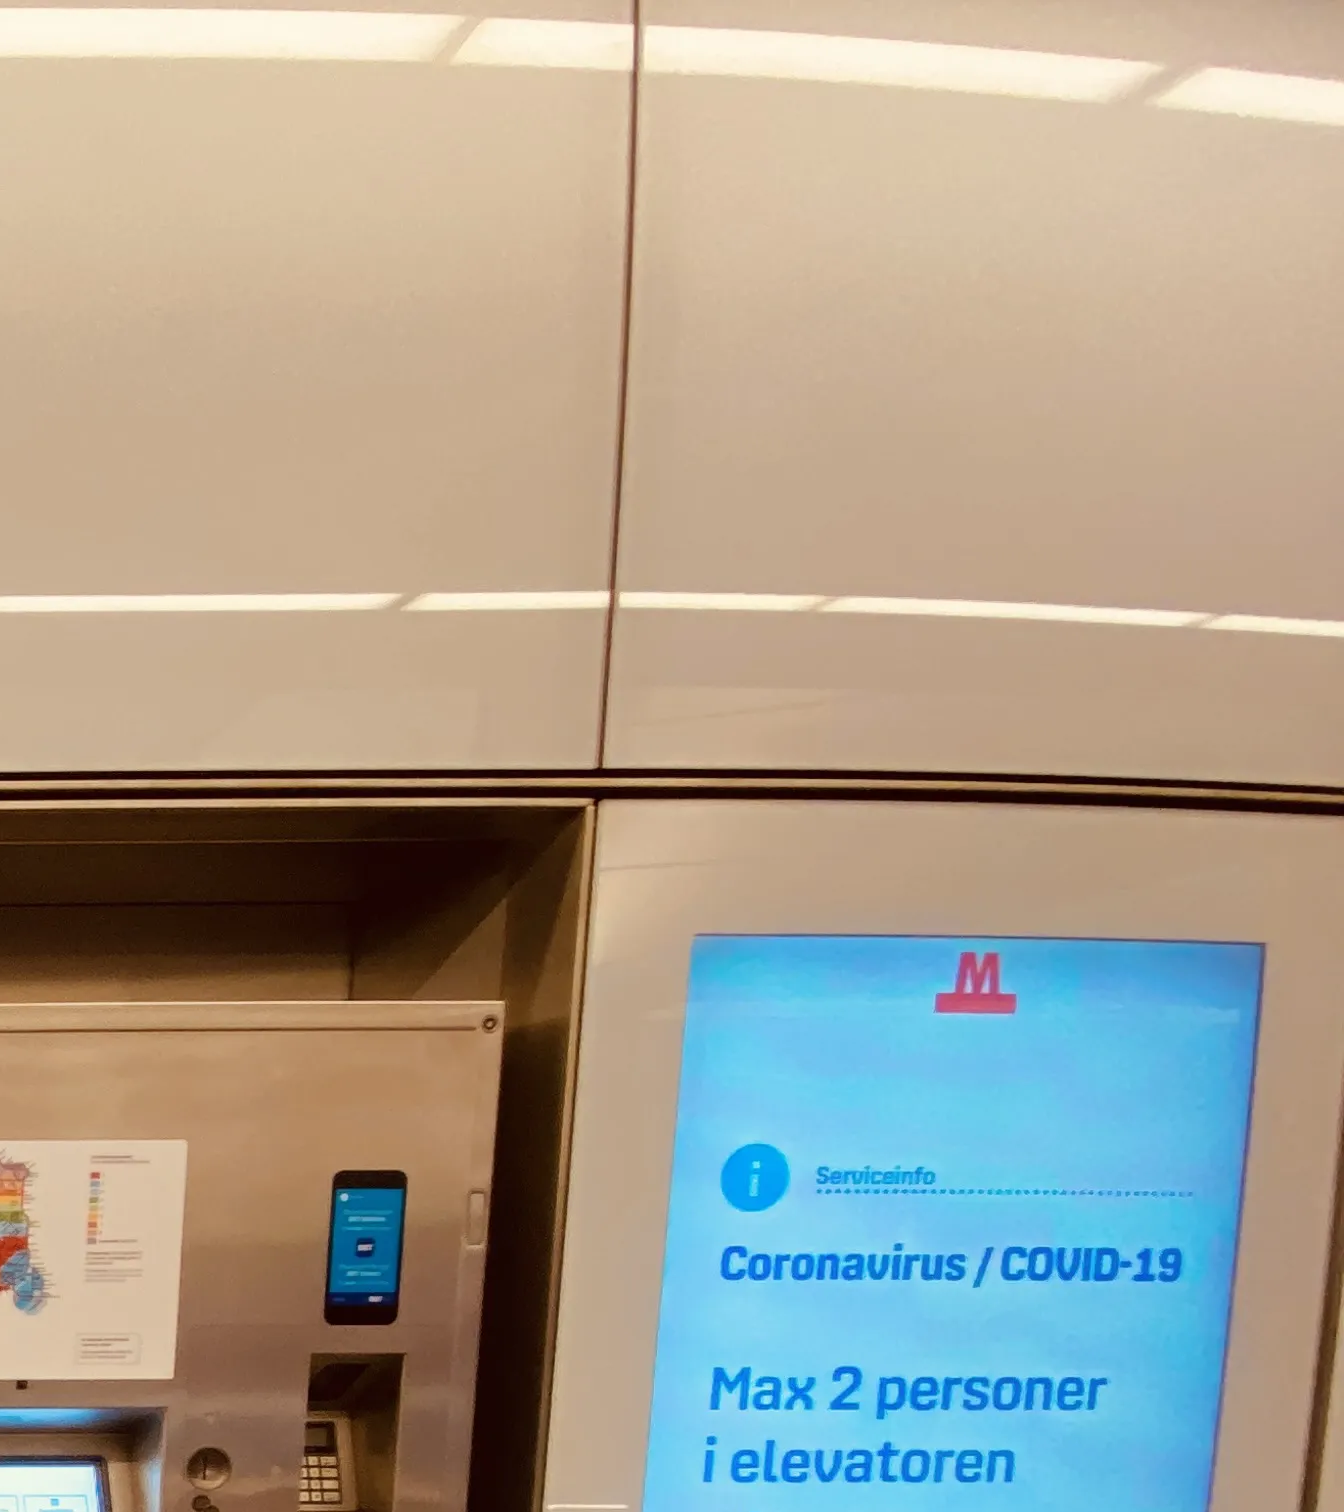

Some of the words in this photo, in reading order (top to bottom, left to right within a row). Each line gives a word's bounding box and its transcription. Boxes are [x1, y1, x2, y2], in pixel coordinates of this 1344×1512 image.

[955, 951, 1001, 996] M
[816, 1165, 937, 1186] Serviceinfo
[720, 1243, 967, 1282] Coronavirus
[972, 1246, 996, 1289] /
[1000, 1246, 1183, 1283] COVID-19
[709, 1366, 816, 1411] Max
[830, 1365, 863, 1410] 2
[876, 1371, 1108, 1420] personer
[702, 1436, 717, 1483] i
[729, 1438, 1015, 1484] elevatoren
